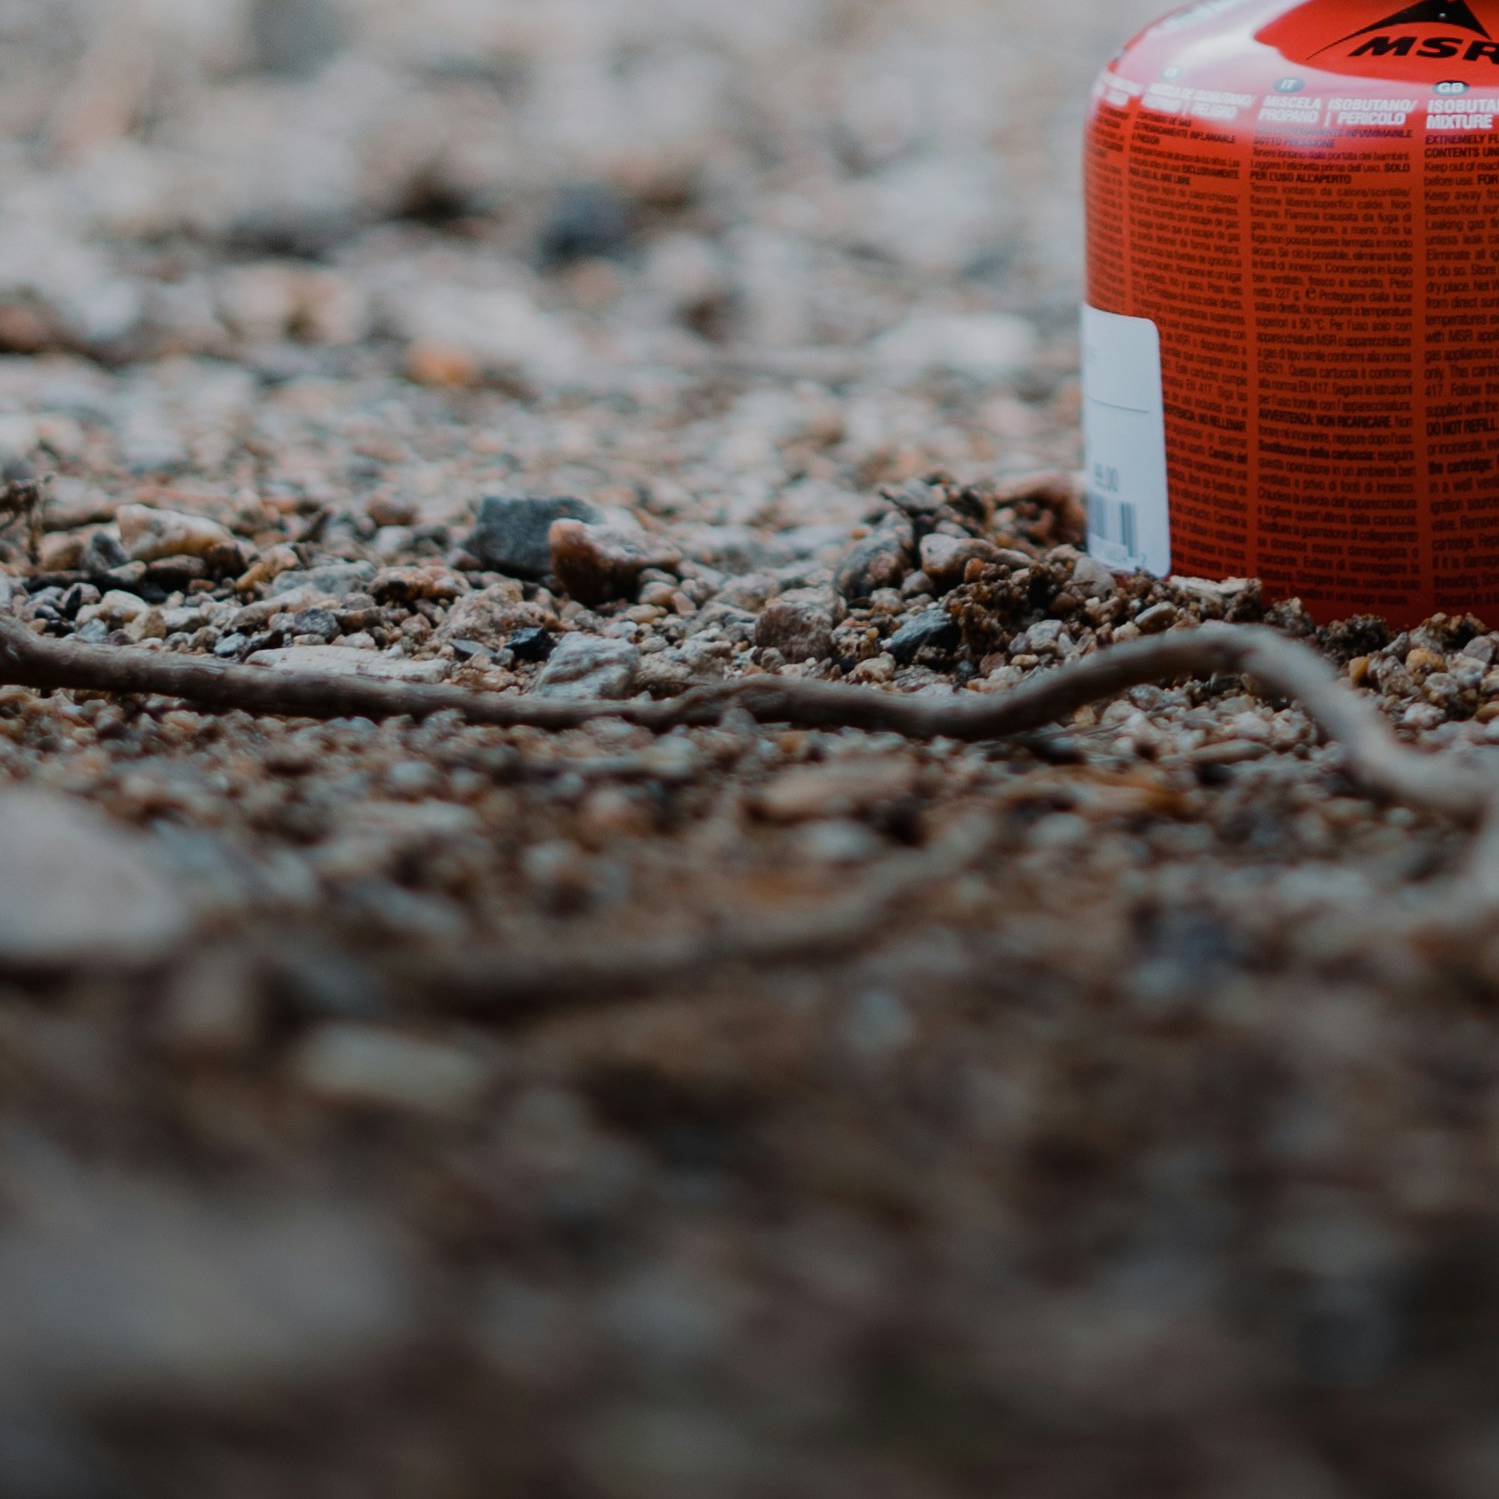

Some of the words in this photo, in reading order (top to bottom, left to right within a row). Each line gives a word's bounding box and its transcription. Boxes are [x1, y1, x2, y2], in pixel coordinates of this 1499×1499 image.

[1281, 80, 1297, 89] IT
[1438, 83, 1464, 92] GB
[1263, 95, 1321, 108] MISCELA
[1328, 98, 1417, 113] ISOBUTANO/
[1258, 108, 1318, 123] PROPANO
[1337, 112, 1406, 125] PERICOLO
[1426, 114, 1493, 129] MIXTURE
[1426, 135, 1485, 145] EXTREMELY
[1425, 147, 1479, 158] CONTENTS
[1384, 163, 1410, 172] SOLO
[1477, 174, 1498, 184] FOR
